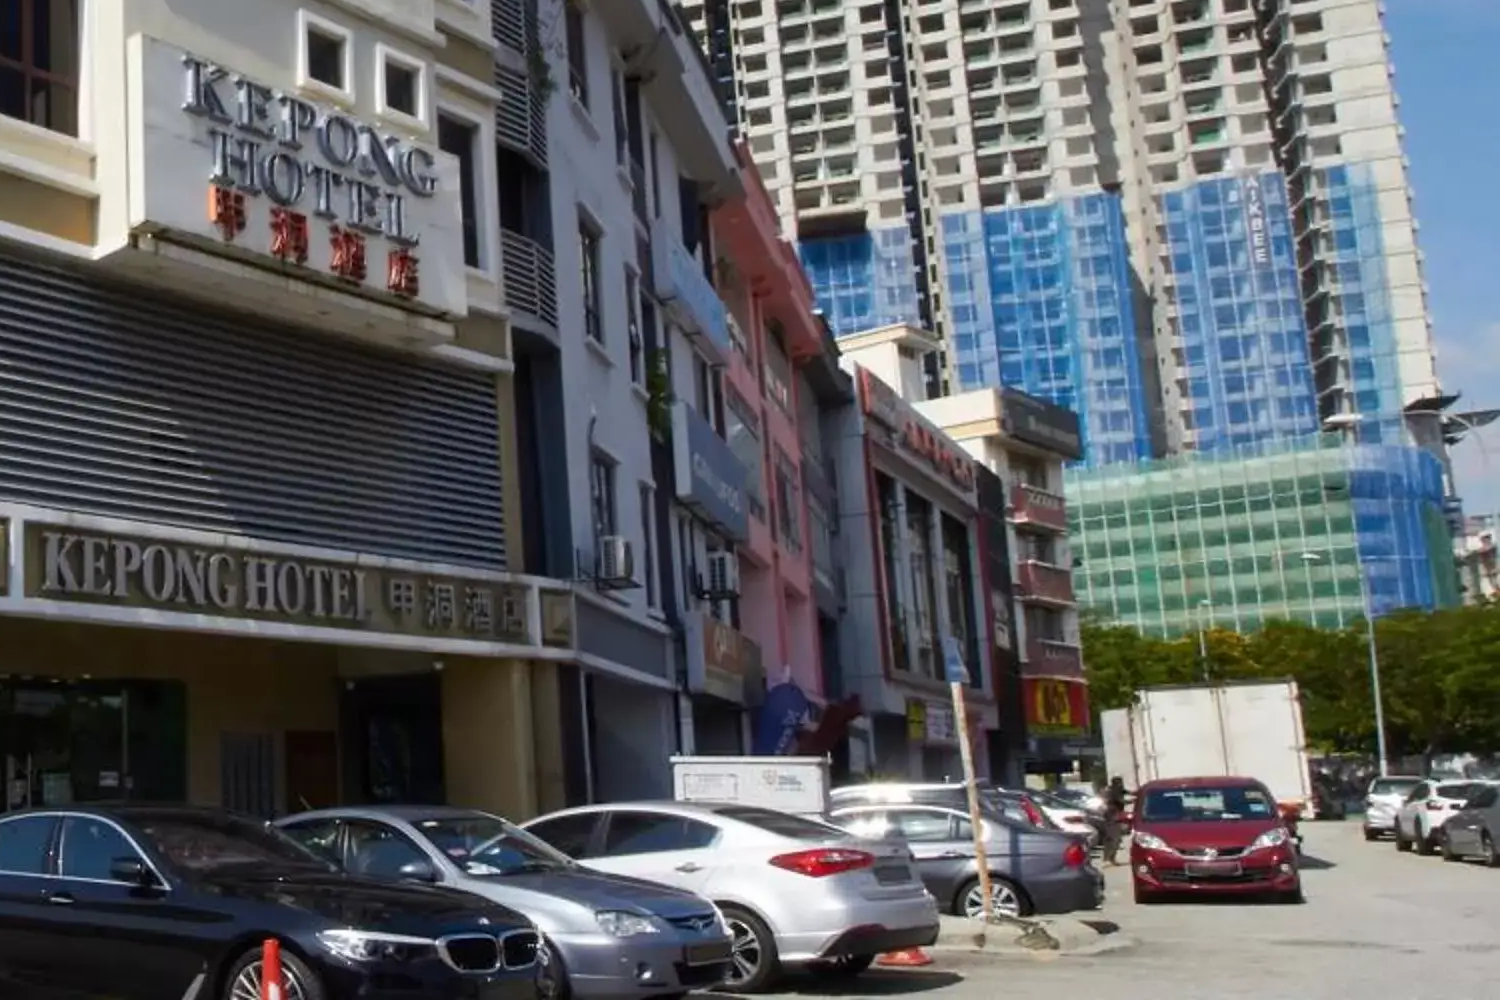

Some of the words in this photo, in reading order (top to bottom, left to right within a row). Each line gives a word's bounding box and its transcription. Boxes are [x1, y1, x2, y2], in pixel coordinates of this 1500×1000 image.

[181, 52, 438, 197] KEPONG
[209, 129, 420, 247] HOTEL
[41, 530, 239, 609] KEPONG
[242, 556, 372, 622] HOTEL
[390, 577, 526, 634] 甲洞酒店
